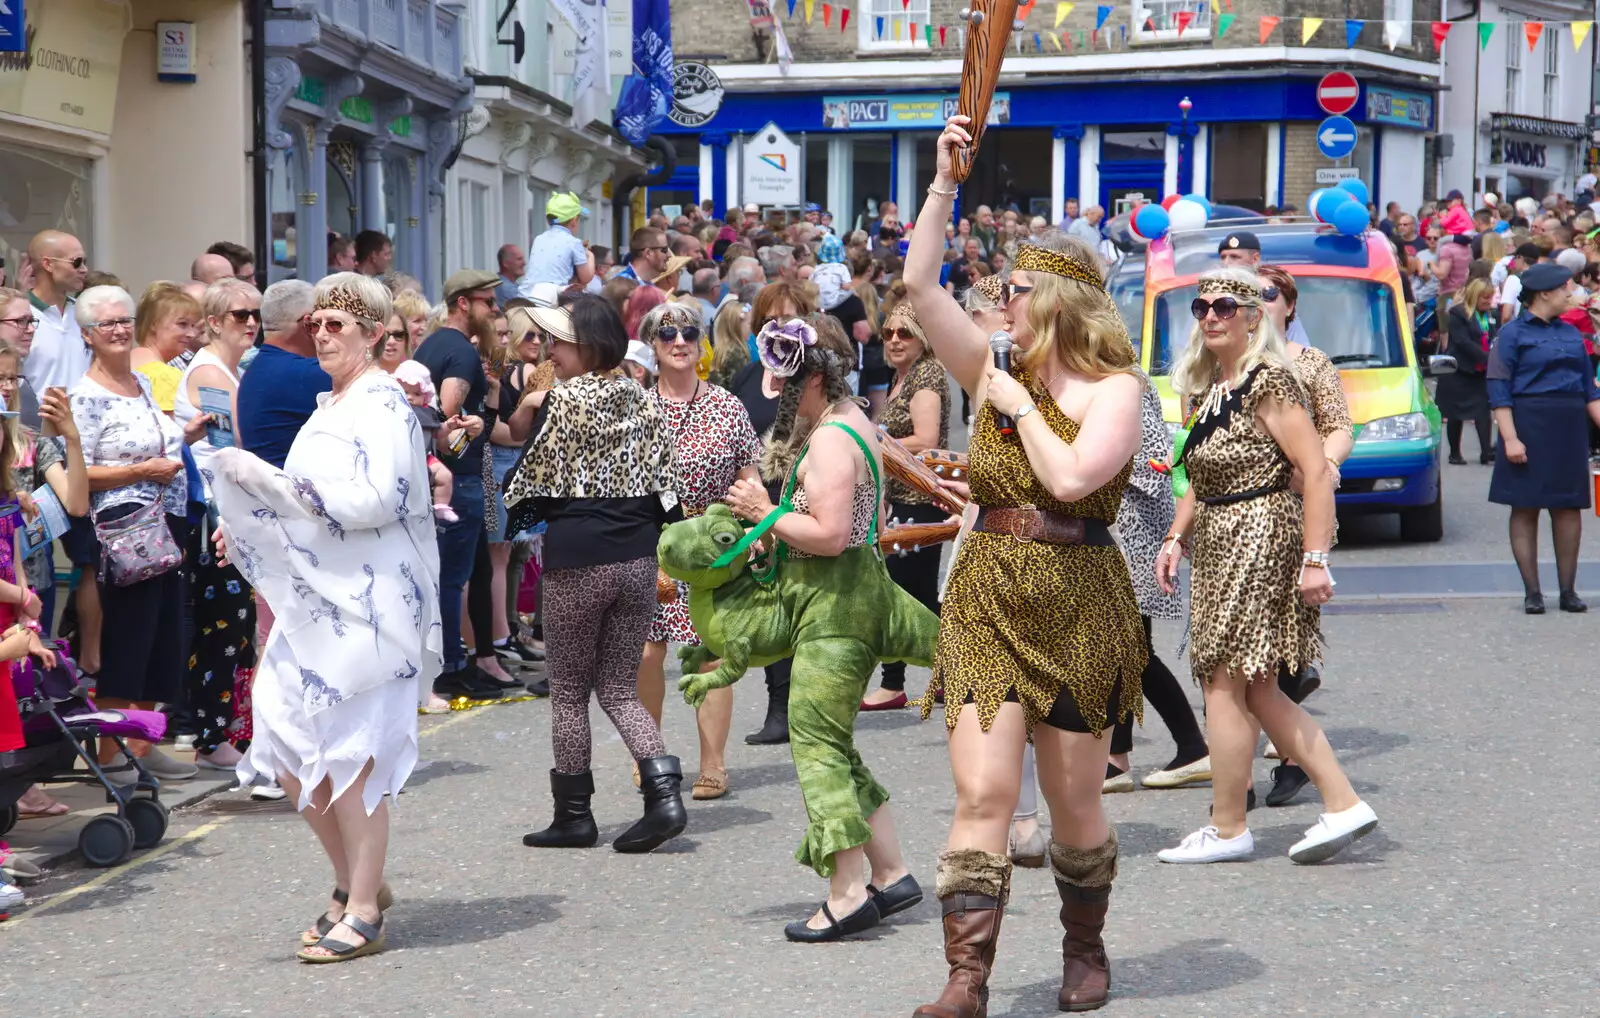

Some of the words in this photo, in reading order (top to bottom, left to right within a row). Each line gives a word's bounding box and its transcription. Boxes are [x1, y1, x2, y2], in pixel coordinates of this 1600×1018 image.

[164, 30, 184, 45] S3
[36, 47, 77, 76] CLOTHING
[77, 58, 90, 79] CO.
[695, 64, 718, 88] FISH
[669, 109, 706, 124] ITCHEN
[850, 102, 887, 120] PACT
[944, 101, 960, 119] PA
